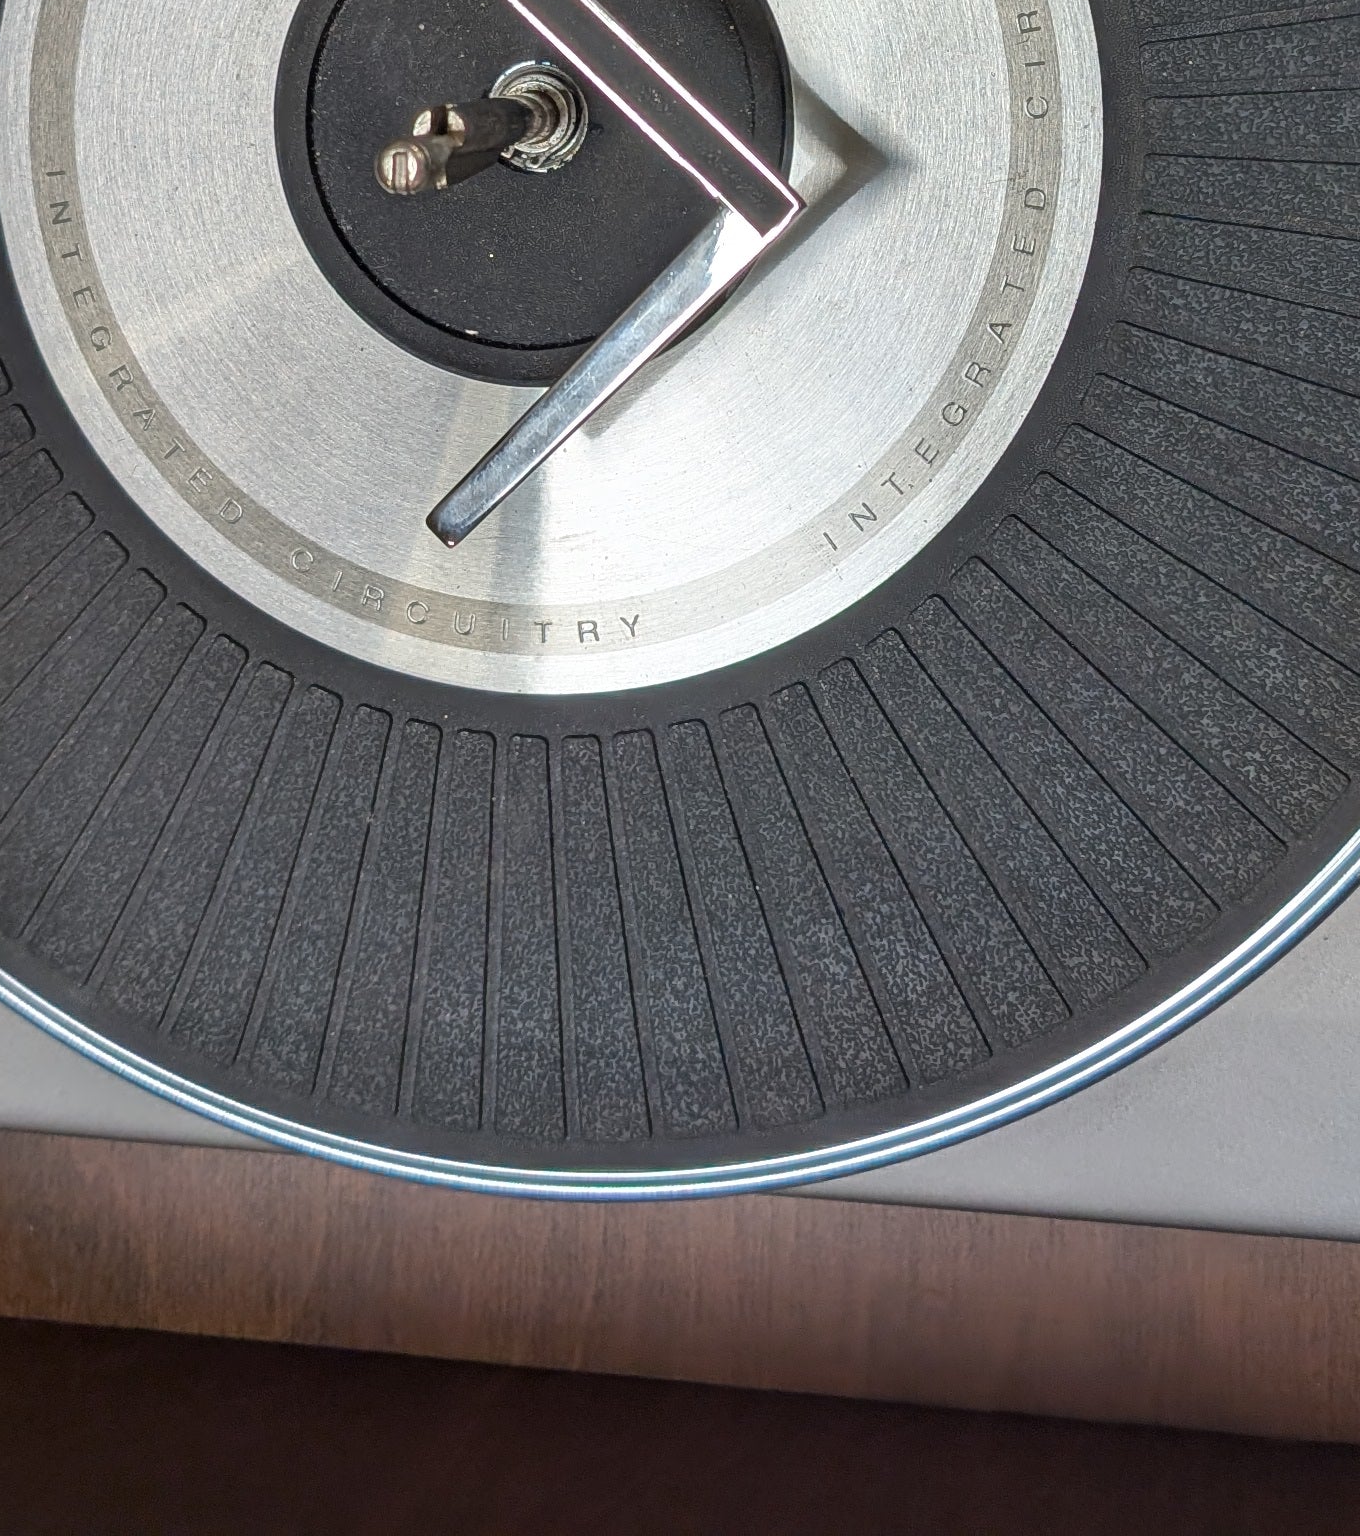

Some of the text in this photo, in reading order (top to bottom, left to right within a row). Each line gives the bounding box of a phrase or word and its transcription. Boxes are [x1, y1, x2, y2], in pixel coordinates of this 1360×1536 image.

[45, 170, 640, 644] INTEGRATED CIRCUITRY
[823, 187, 1047, 551] INTEGRATED
